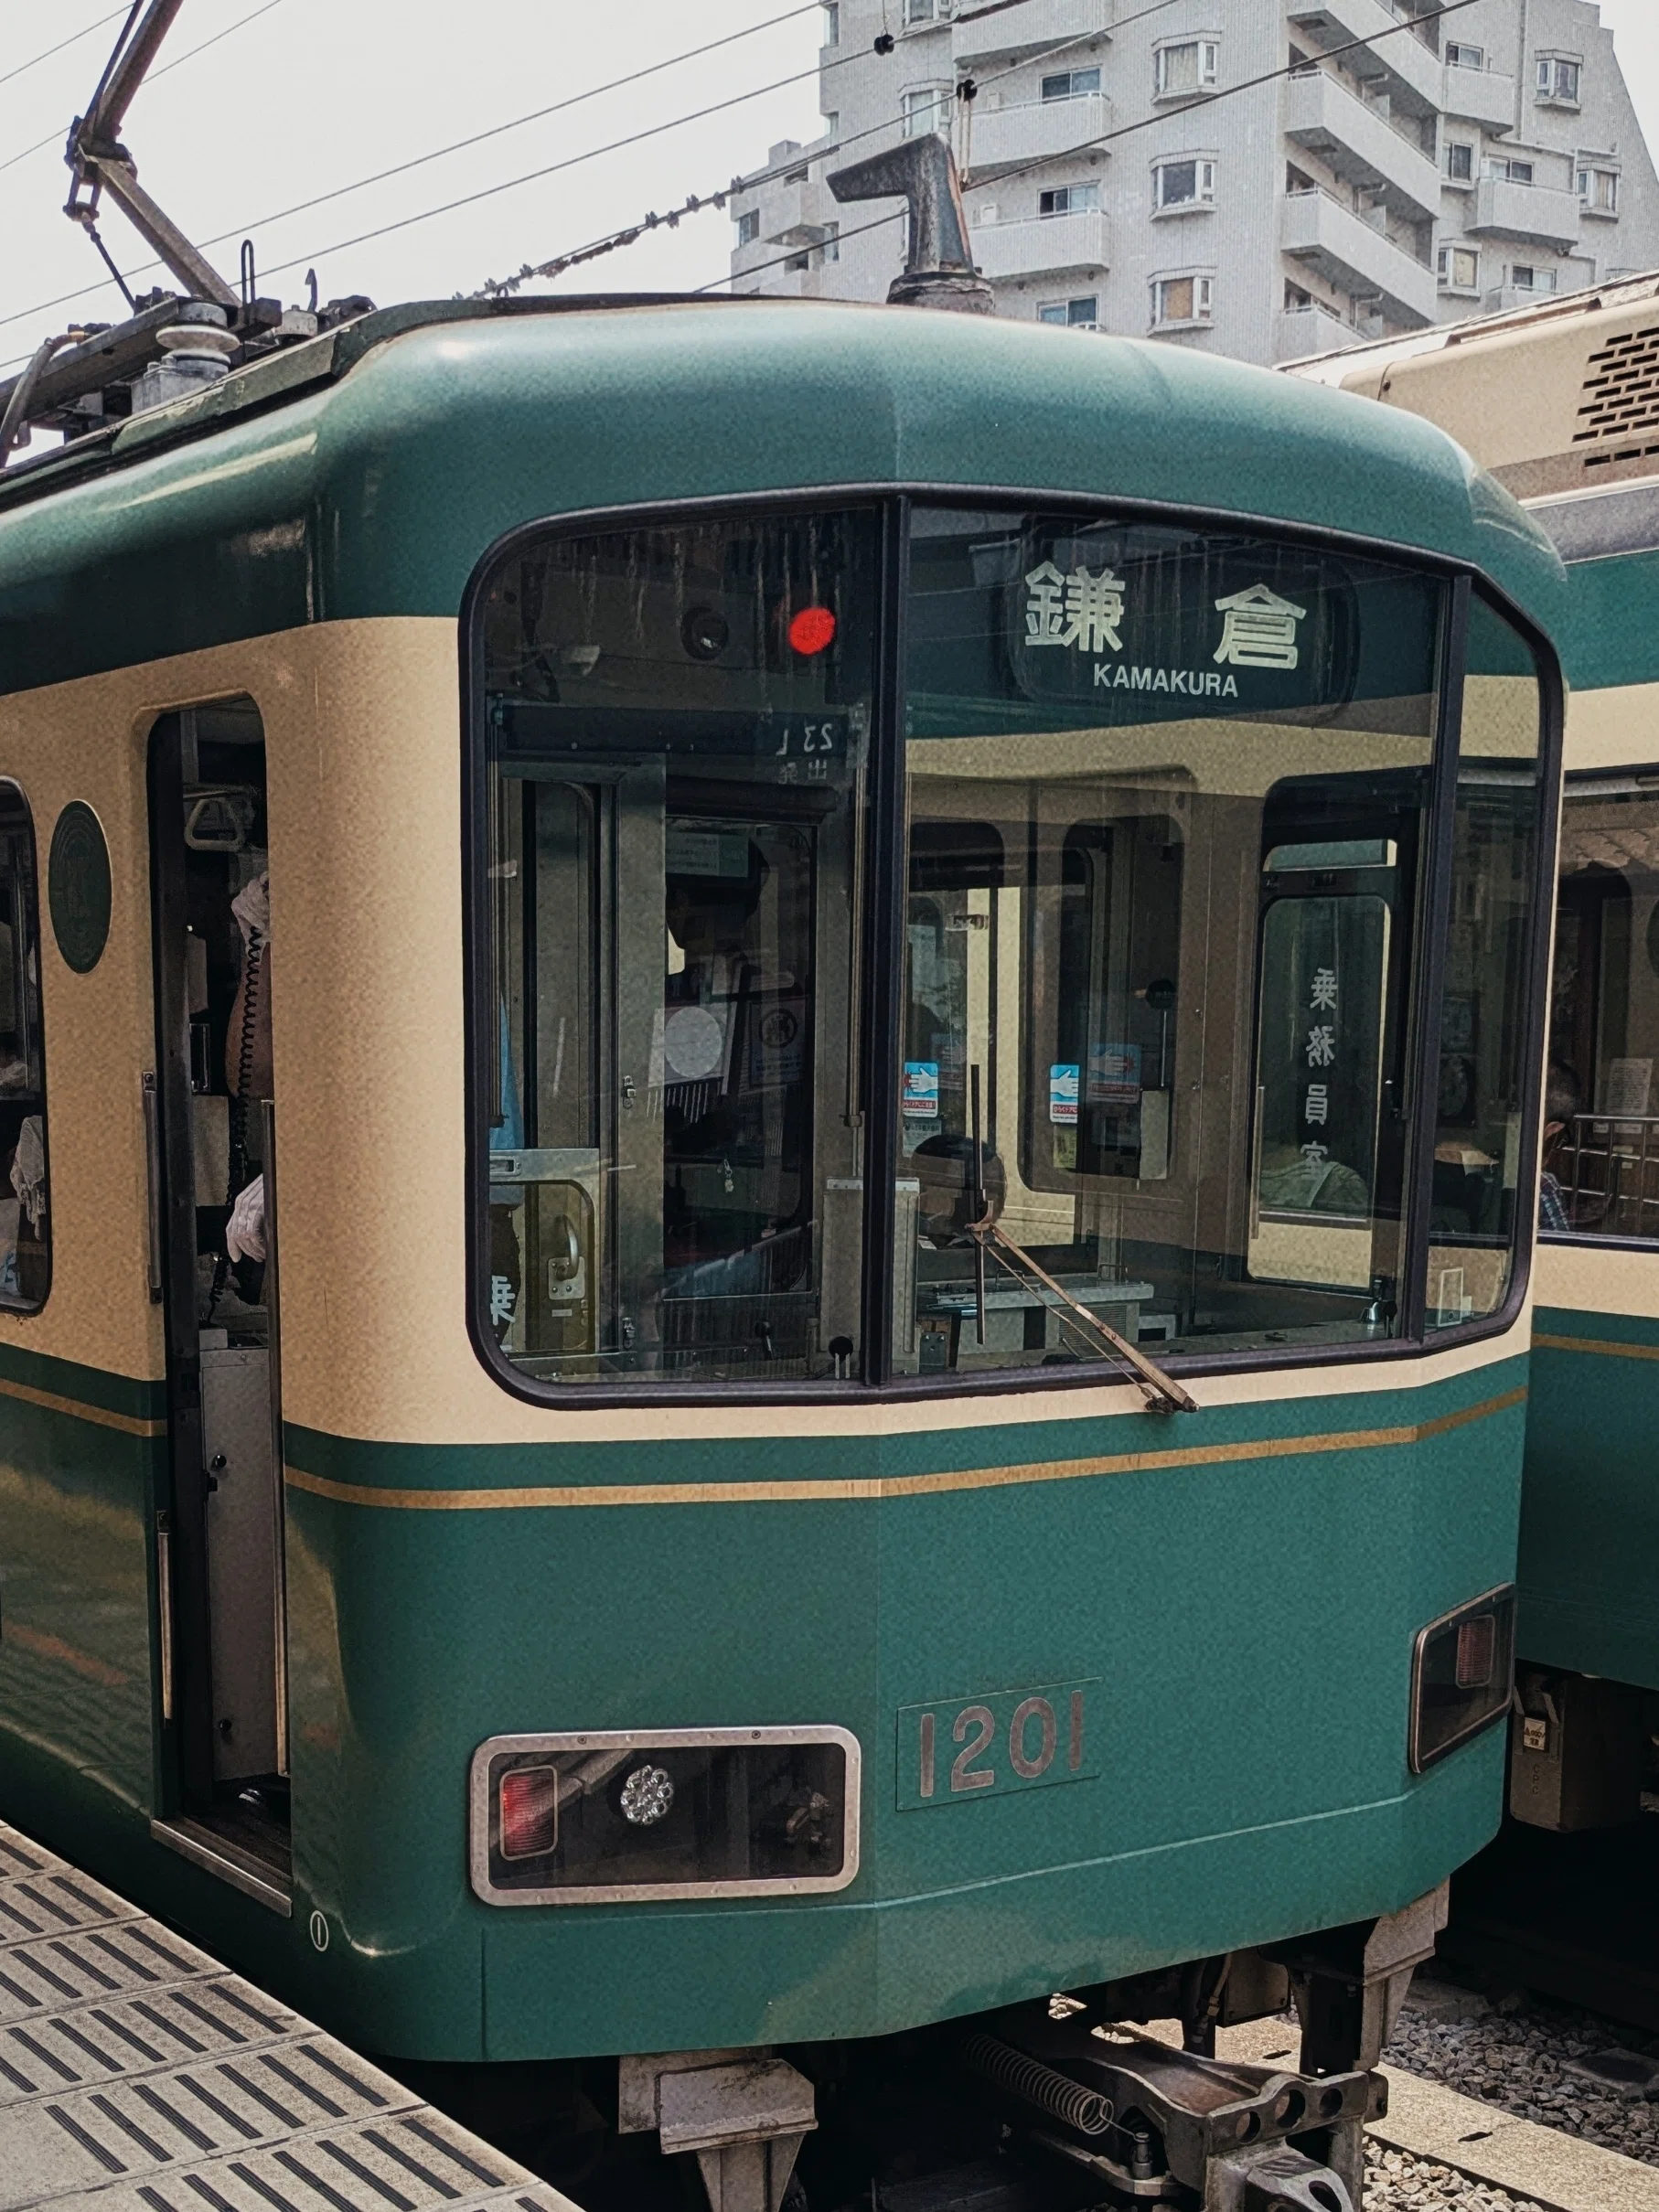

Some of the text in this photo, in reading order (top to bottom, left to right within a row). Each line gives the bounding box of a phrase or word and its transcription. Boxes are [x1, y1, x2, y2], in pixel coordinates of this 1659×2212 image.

[1025, 561, 1307, 670] 鎌倉
[1093, 663, 1238, 698] KAMAKURA
[920, 1690, 1083, 1798] 1201
